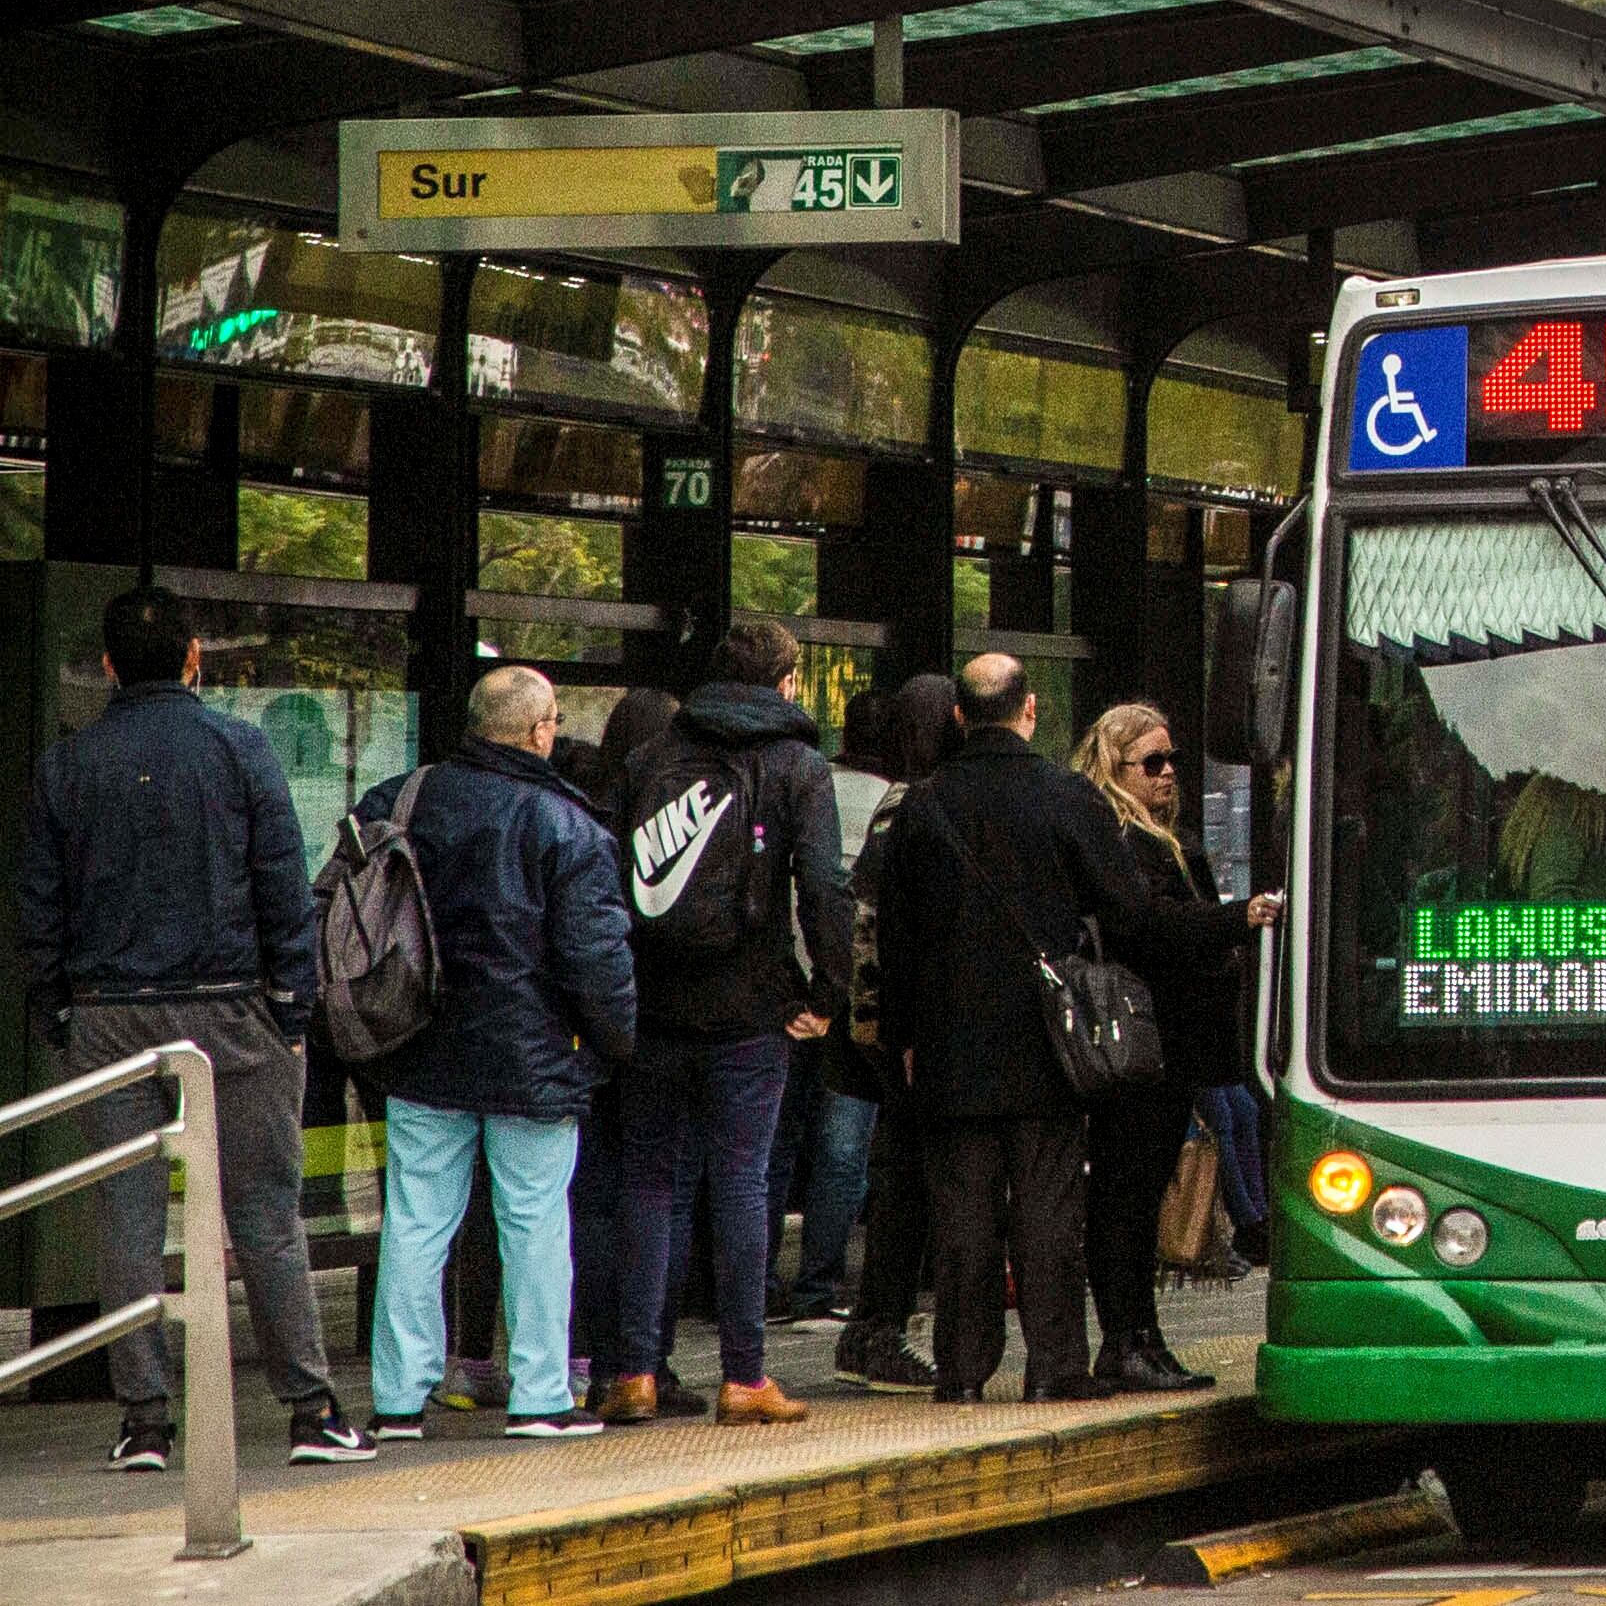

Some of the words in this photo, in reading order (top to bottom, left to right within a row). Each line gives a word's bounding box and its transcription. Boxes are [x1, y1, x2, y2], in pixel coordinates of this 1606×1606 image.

[410, 164, 488, 199] Sur
[792, 169, 844, 208] 45
[665, 472, 710, 505] 70
[633, 780, 711, 880] NIKE
